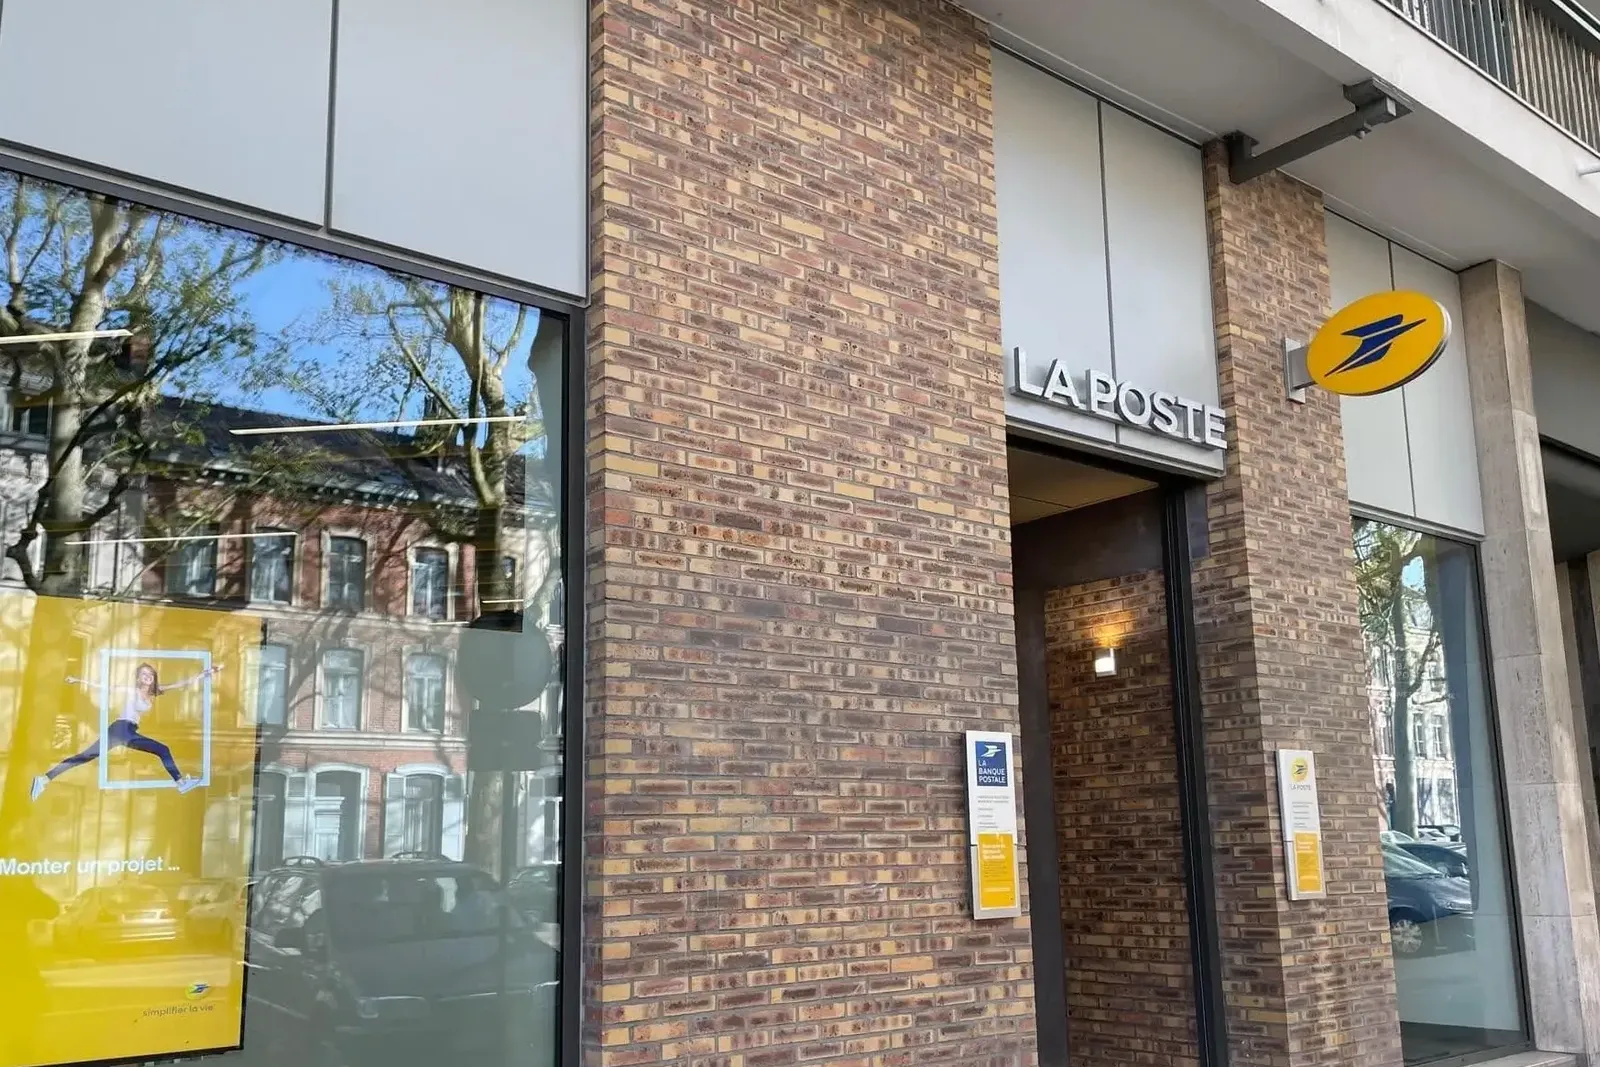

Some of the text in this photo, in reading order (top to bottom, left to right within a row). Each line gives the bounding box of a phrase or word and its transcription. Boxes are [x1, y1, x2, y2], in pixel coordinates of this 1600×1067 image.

[1012, 346, 1228, 449] LA POSTE
[978, 767, 1005, 775] BANQUE
[979, 775, 1006, 783] POSTALE
[0, 857, 71, 876] Monter
[77, 860, 101, 874] un
[107, 856, 164, 876] projet
[143, 1006, 187, 1017] simplifier
